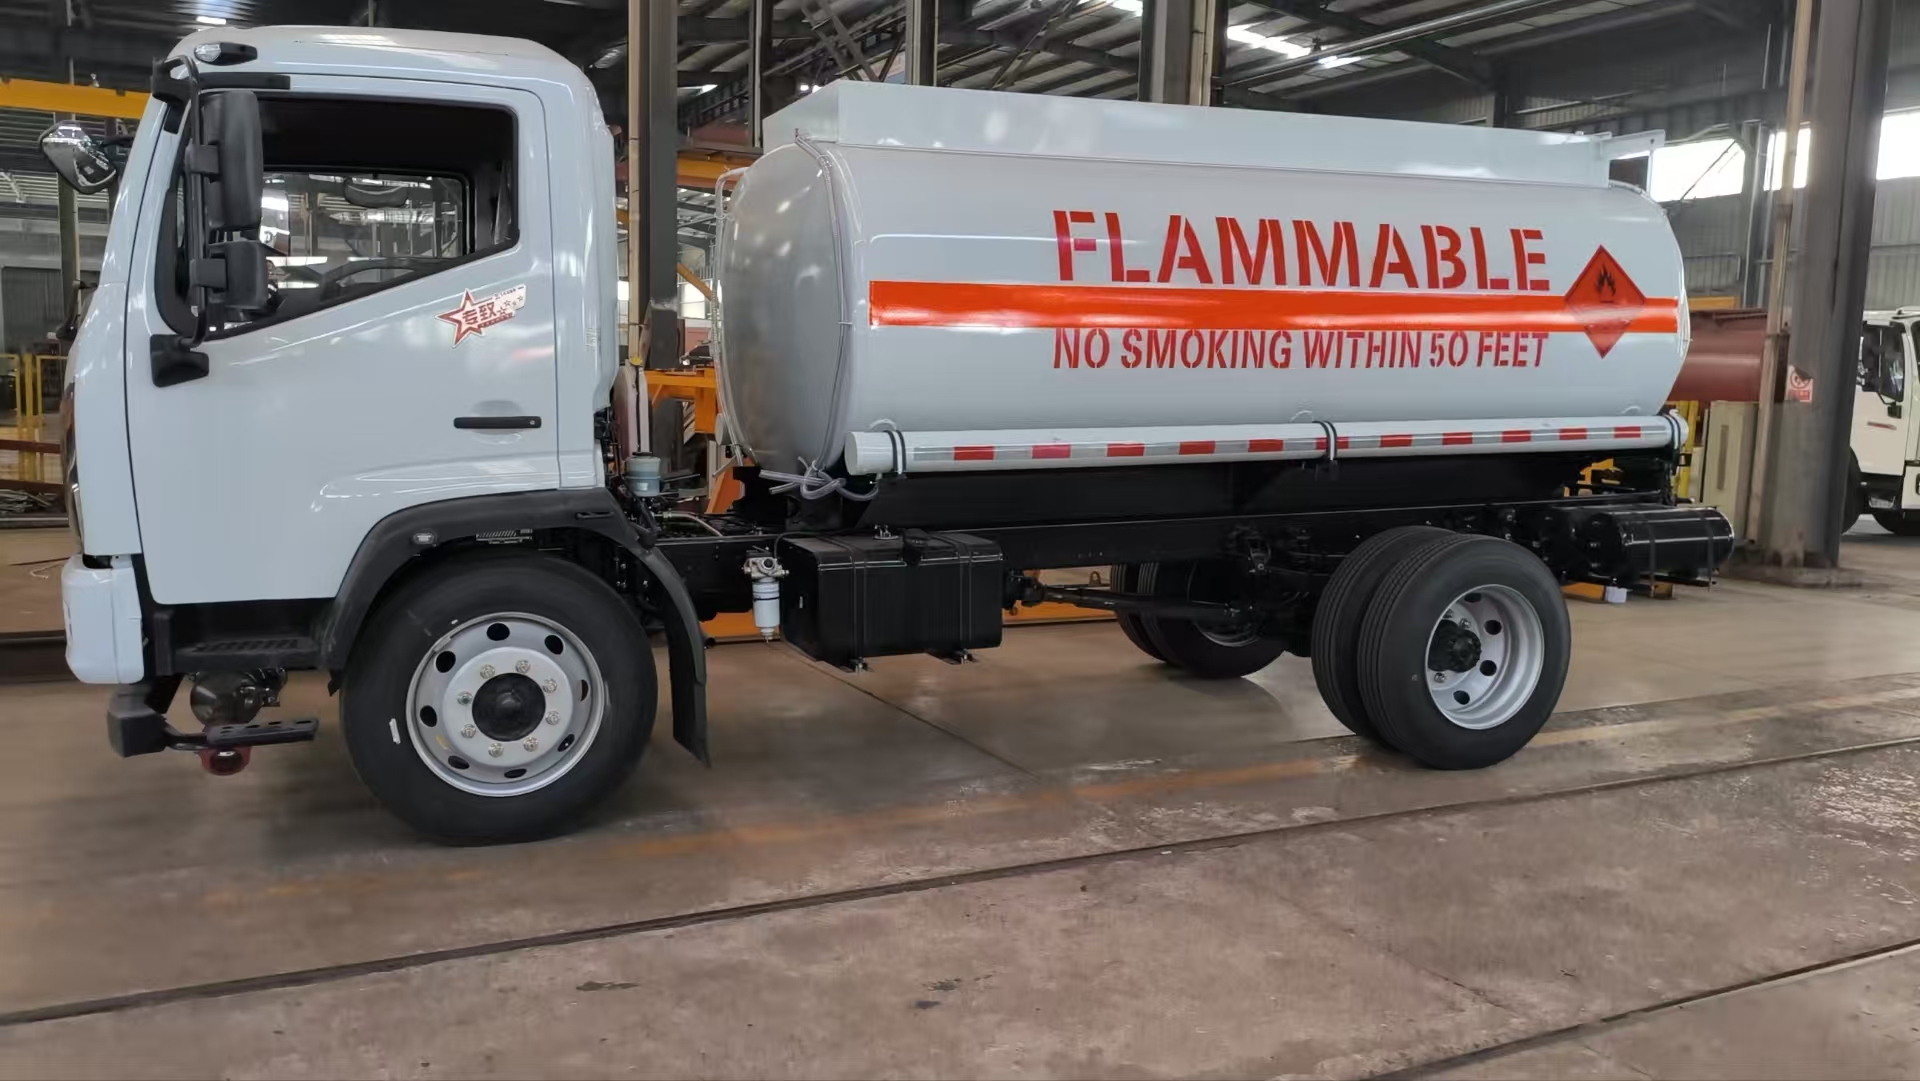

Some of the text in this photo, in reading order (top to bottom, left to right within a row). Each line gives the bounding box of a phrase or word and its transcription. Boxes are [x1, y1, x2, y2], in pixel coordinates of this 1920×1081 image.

[1053, 210, 1549, 290] FLAMMABLE
[462, 301, 497, 325] 专致
[1053, 328, 1549, 369] NO SMOKING WITHIN 50 FEET
